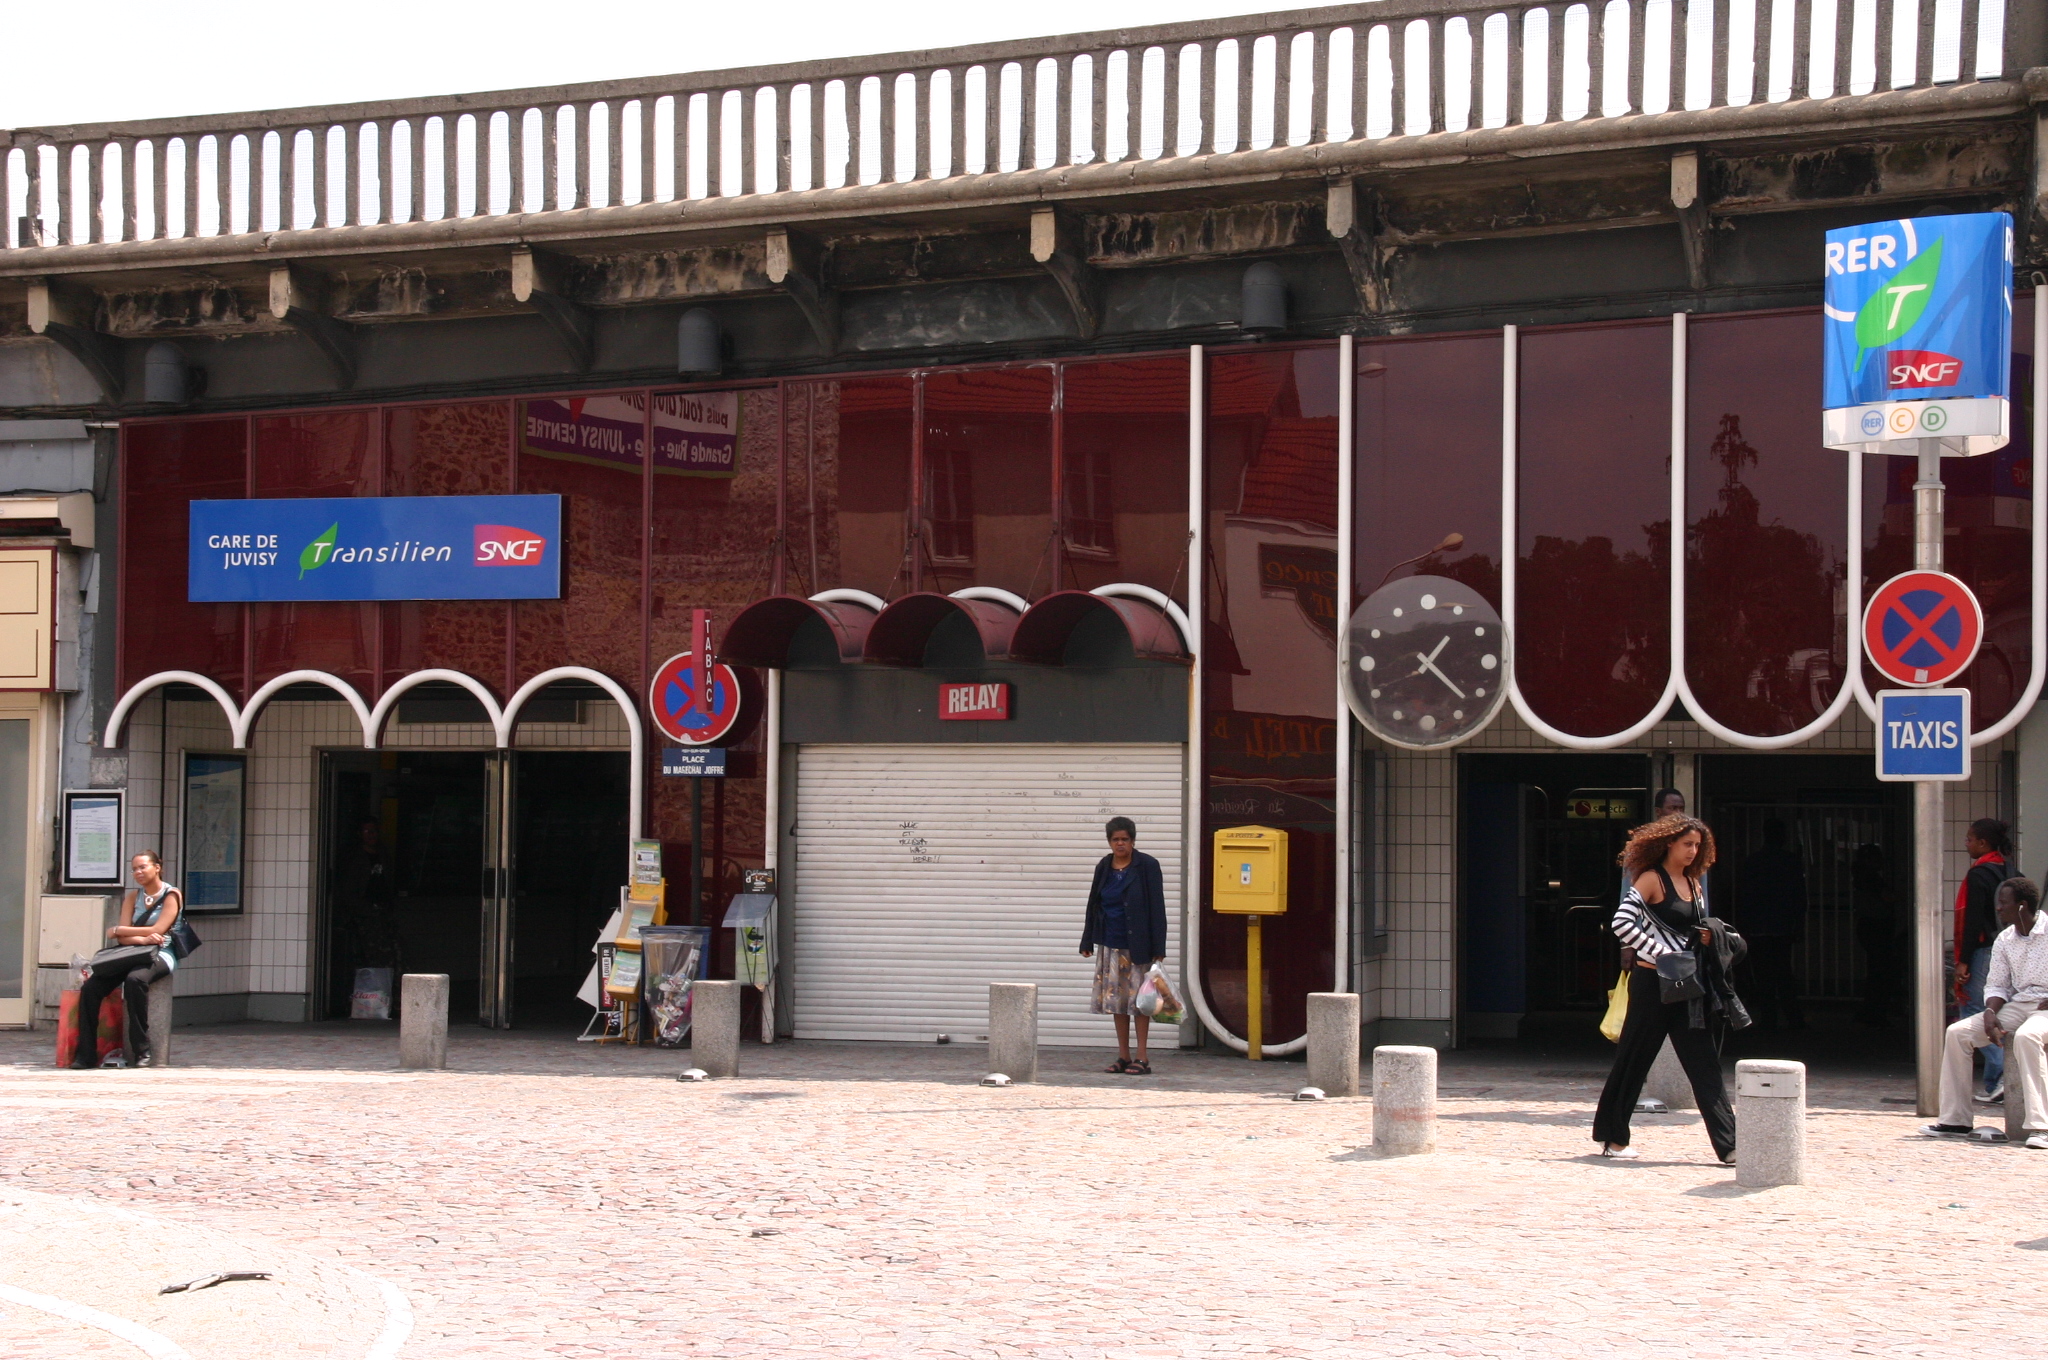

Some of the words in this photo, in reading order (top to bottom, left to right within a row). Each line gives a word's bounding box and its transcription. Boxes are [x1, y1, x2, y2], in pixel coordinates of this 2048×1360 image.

[1826, 235, 1896, 277] RER
[1890, 362, 1958, 385] SNCF
[1864, 417, 1881, 428] RER
[1896, 414, 1905, 427] C
[1928, 412, 1939, 426] D
[208, 535, 250, 549] GARE
[256, 535, 278, 548] DE
[313, 541, 452, 564] Transilien
[476, 539, 541, 562] SNCF
[224, 552, 277, 569] JUVISY
[705, 620, 713, 702] TABAC
[948, 683, 1000, 714] RELAY
[1888, 721, 1958, 749] TAXIS
[663, 765, 671, 774] DU
[704, 765, 724, 774] JOFFRE
